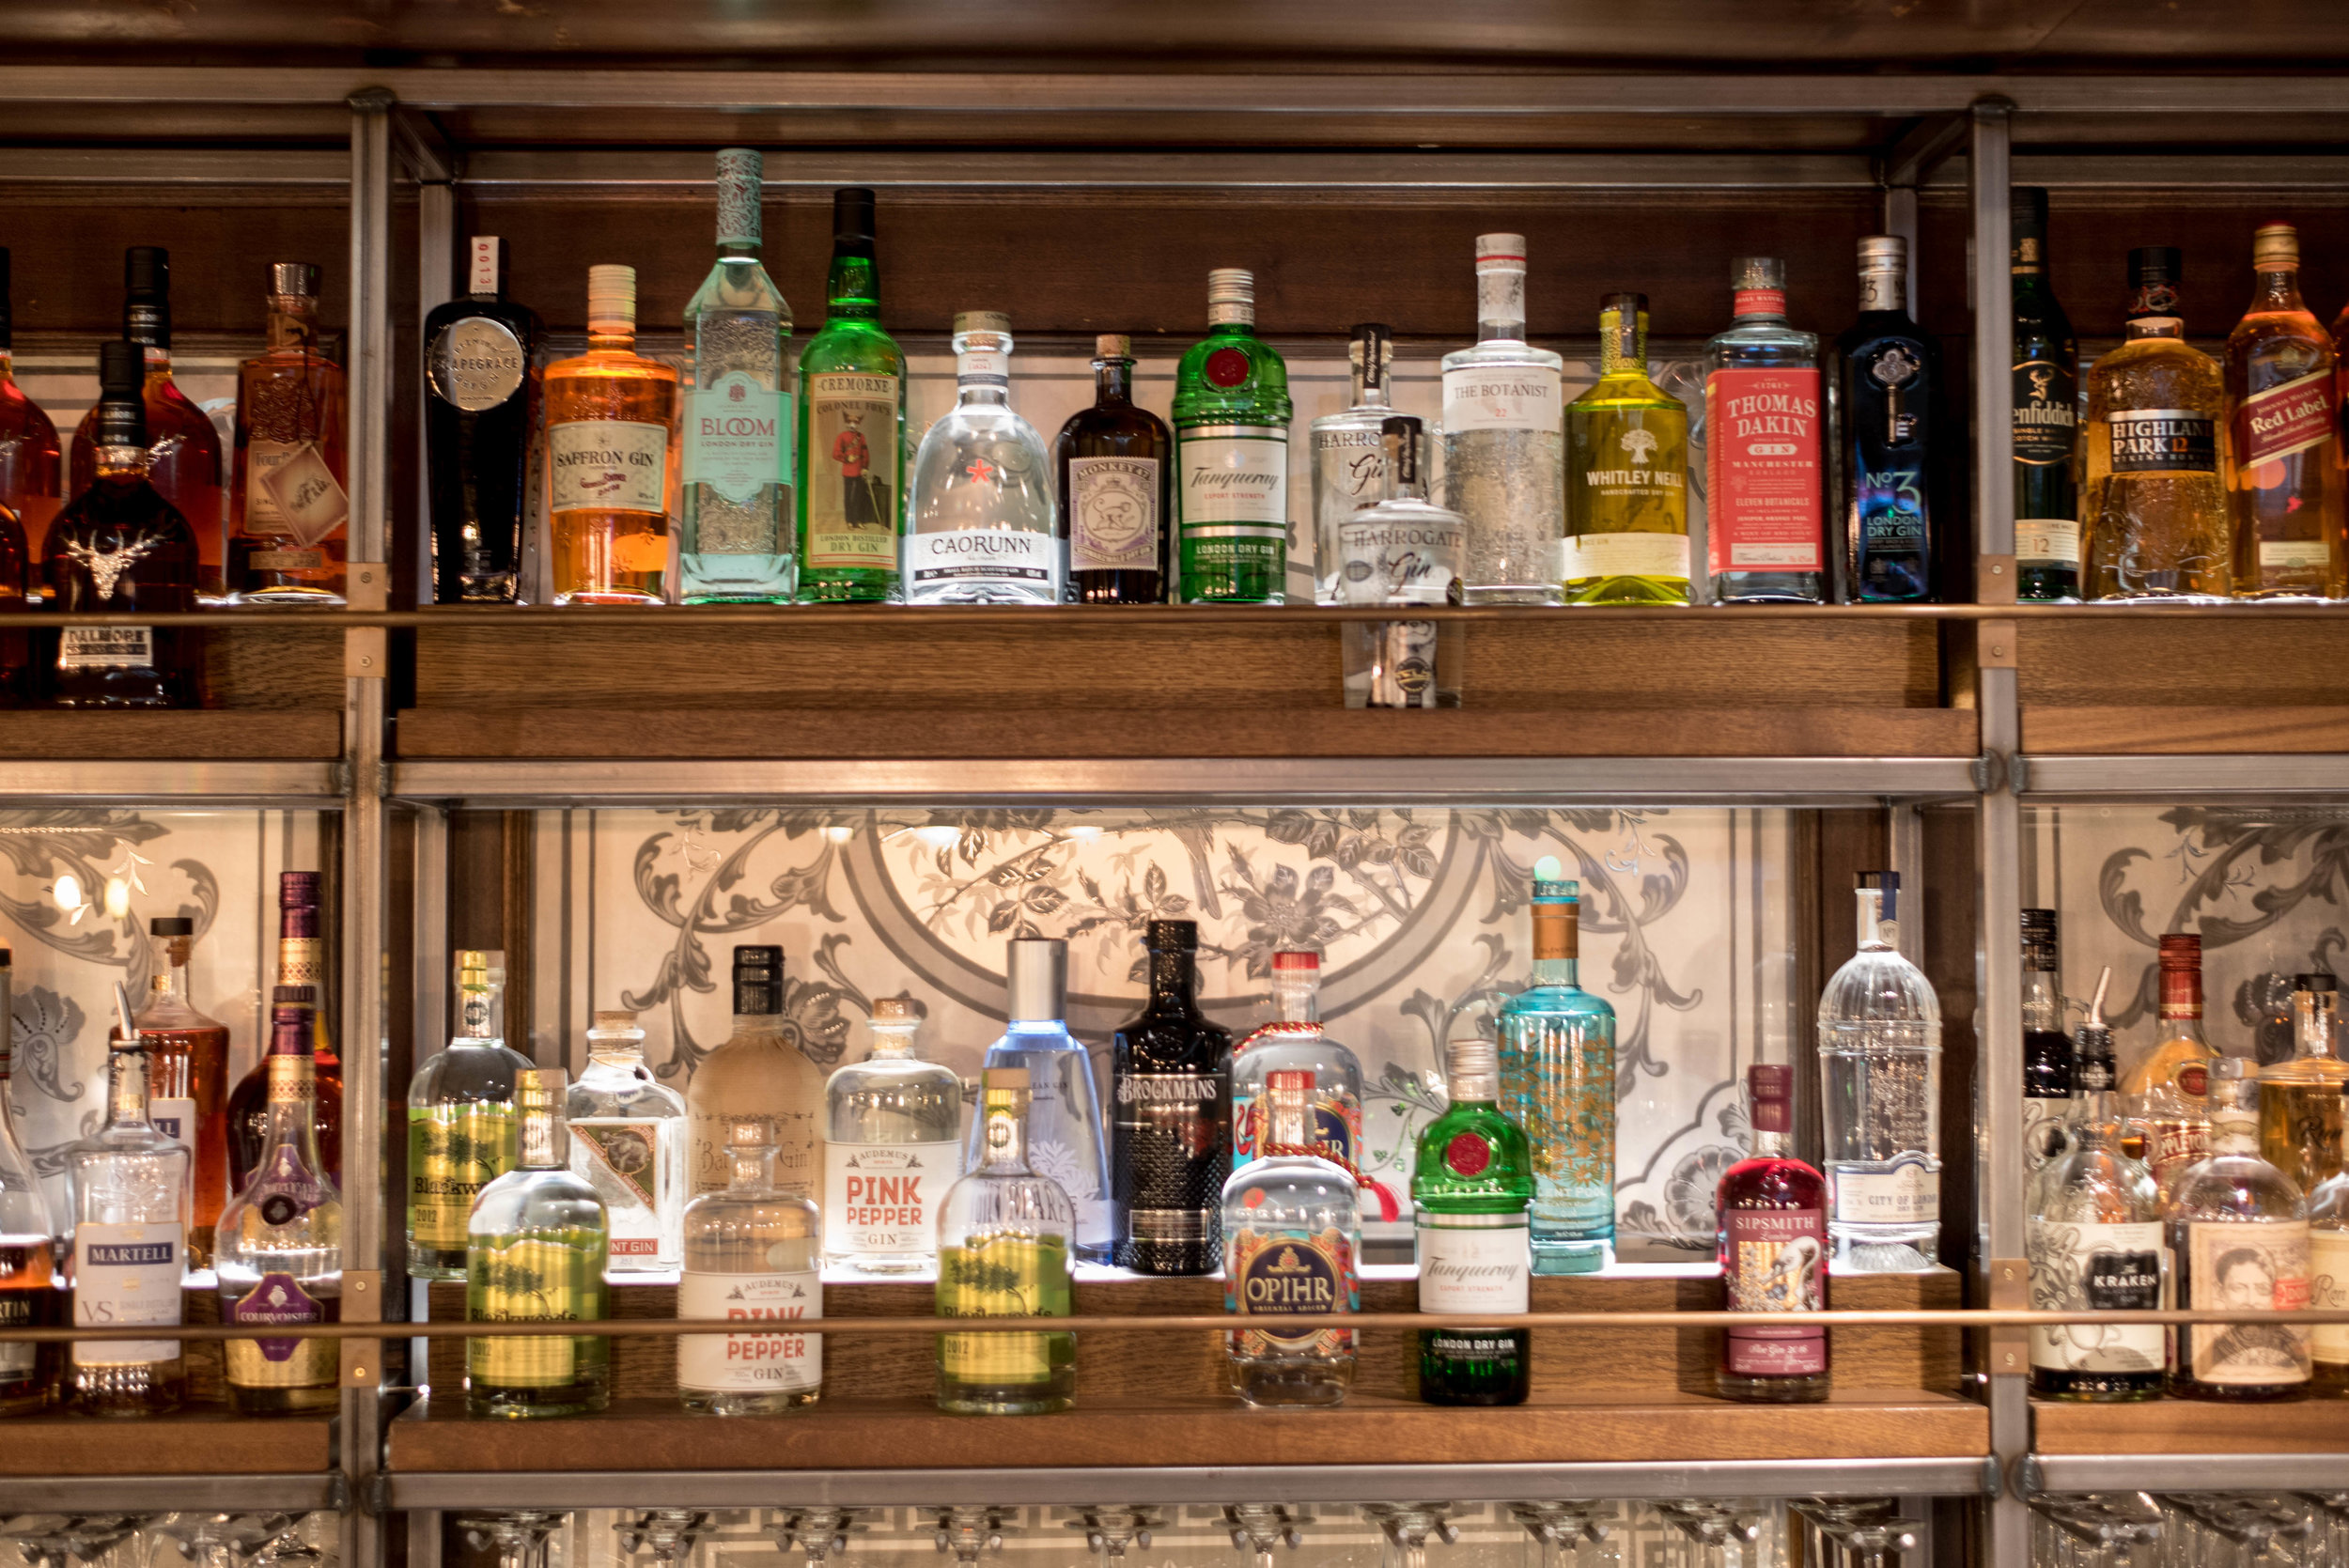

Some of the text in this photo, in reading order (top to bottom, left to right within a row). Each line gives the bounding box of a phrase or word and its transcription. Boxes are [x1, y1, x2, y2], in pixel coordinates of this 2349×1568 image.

[820, 378, 889, 393] CREMORNE
[1455, 383, 1548, 399] THE BOTANIST
[817, 401, 862, 414] COLONEL
[1495, 408, 1508, 418] 22
[1727, 395, 1817, 418] THOMAS
[2013, 399, 2075, 427] enfiddich
[2250, 395, 2330, 435] Red Label
[700, 417, 775, 437] BLOOM
[1736, 416, 1808, 438] DAKIN
[1318, 432, 1381, 451] HARRO
[1753, 445, 1790, 454] GIN
[2112, 437, 2188, 456] PARK 12
[556, 451, 655, 468] SAFFRON GIN
[2112, 454, 2164, 463] VIKING
[1078, 462, 1134, 478] MONKEY
[1190, 466, 1279, 490] Tanqueray
[1586, 470, 1683, 488] WHITLEY NEILL
[1891, 471, 1922, 515] 3
[1735, 497, 1810, 506] ELEVEN BOTANICALS
[1866, 516, 1922, 526] LONDON
[1354, 529, 1461, 548] HARROGATE
[1866, 526, 1922, 536] DRY GIN
[830, 542, 879, 552] DRY GIN
[852, 535, 888, 544] DISTILLED
[931, 536, 1032, 555] CAORUNN
[2031, 537, 2050, 553] 12
[1196, 544, 1275, 555] LONDON DRY GIN
[1387, 551, 1432, 595] Gin
[69, 629, 145, 643] DALMORE
[1117, 1074, 1217, 1104] BROCKMANS
[779, 1141, 809, 1169] Gin
[860, 1149, 910, 1160] AUDEMUS
[847, 1175, 923, 1205] PINK
[1535, 1188, 1572, 1198] LENT
[1868, 1194, 1893, 1206] CITY
[1896, 1195, 1910, 1205] OF
[416, 1208, 437, 1222] 2012
[847, 1206, 923, 1226] PEPPER
[1735, 1217, 1816, 1230] SIPSMITH
[630, 1241, 654, 1252] GIN
[867, 1233, 897, 1246] GIN
[92, 1247, 169, 1263] MARTELL
[1426, 1255, 1519, 1282] Tanqueray
[744, 1280, 794, 1292] AUDEMUS
[1246, 1276, 1333, 1302] OPIHR
[2093, 1274, 2157, 1288] KRAKEN
[82, 1300, 114, 1324] VS
[727, 1339, 805, 1360] PEPPER
[946, 1339, 970, 1355] 2012
[1432, 1338, 1516, 1349] LONDON DRY GIN
[754, 1368, 784, 1381] GIN
